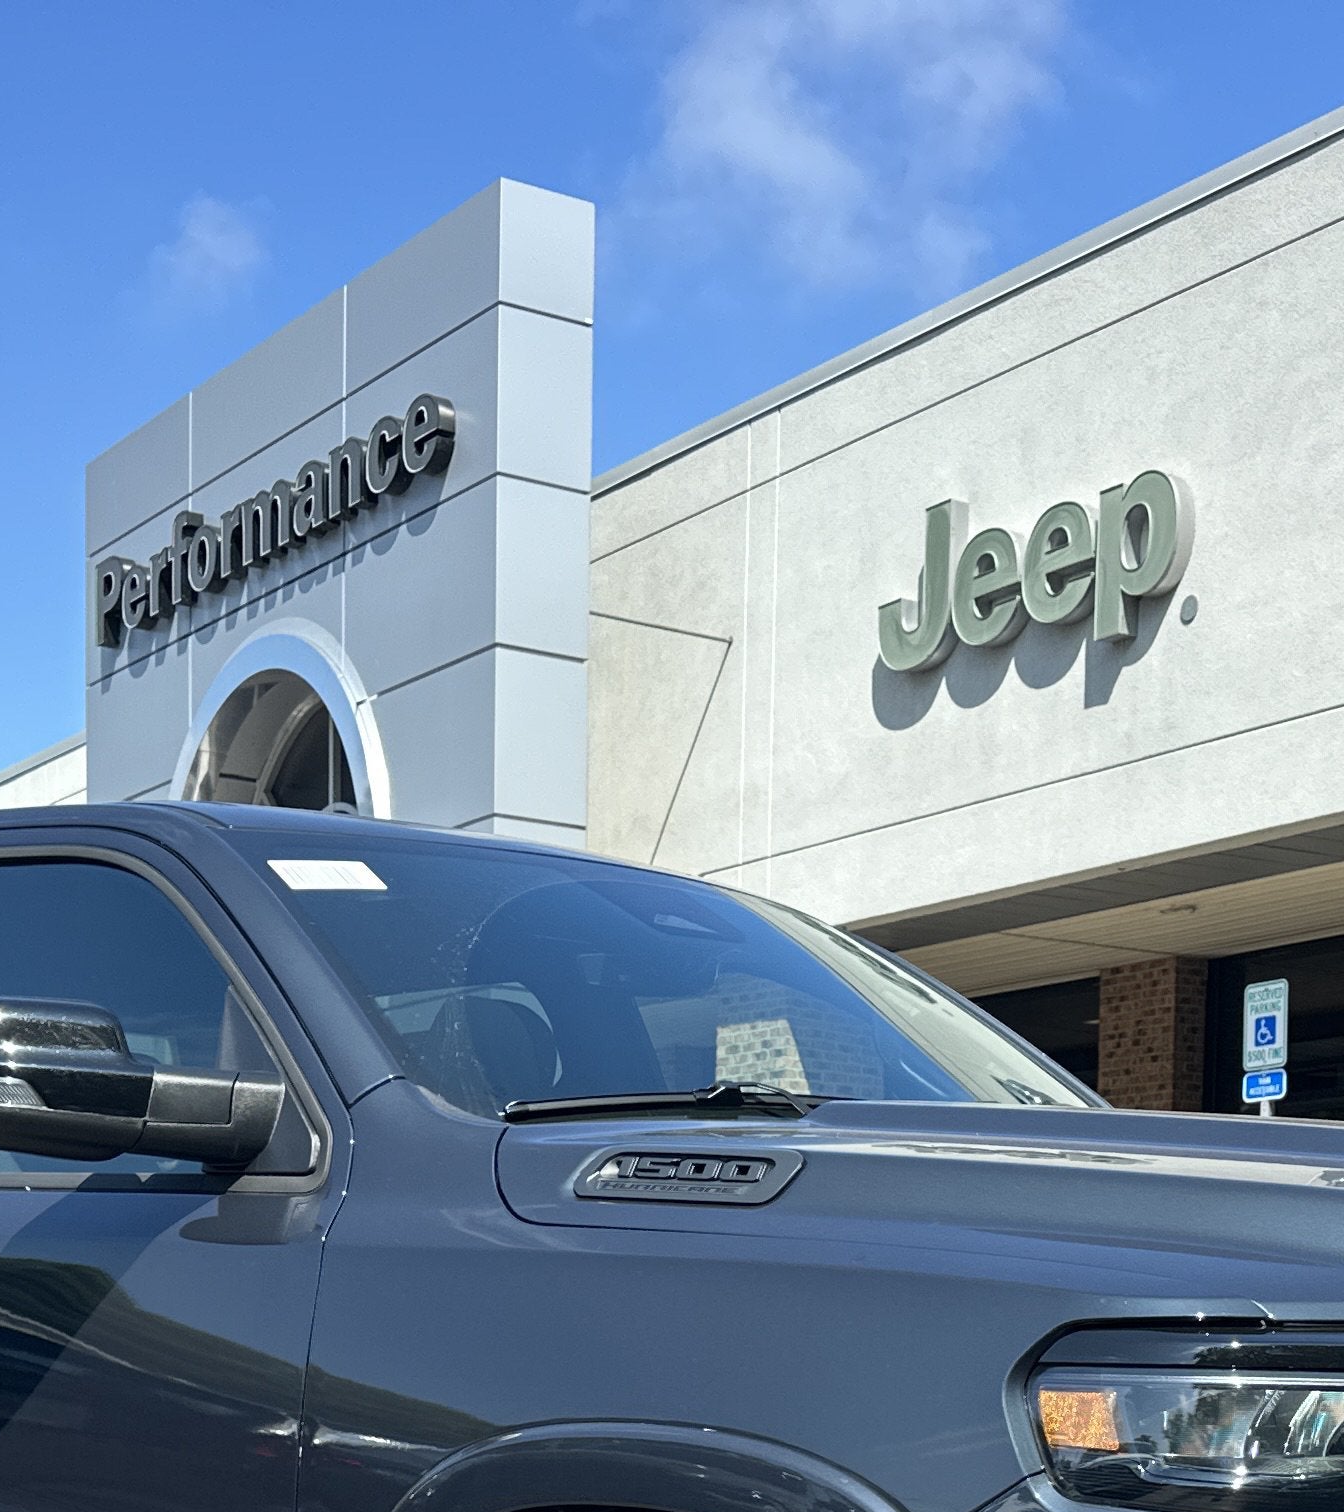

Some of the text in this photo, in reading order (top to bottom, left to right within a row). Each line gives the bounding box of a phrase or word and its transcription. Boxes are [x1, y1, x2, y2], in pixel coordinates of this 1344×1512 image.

[95, 393, 456, 648] Performance
[878, 469, 1196, 672] Jeep
[1249, 1001, 1282, 1016] PARKING
[1267, 1047, 1284, 1060] FINE
[599, 1156, 769, 1184] 1500
